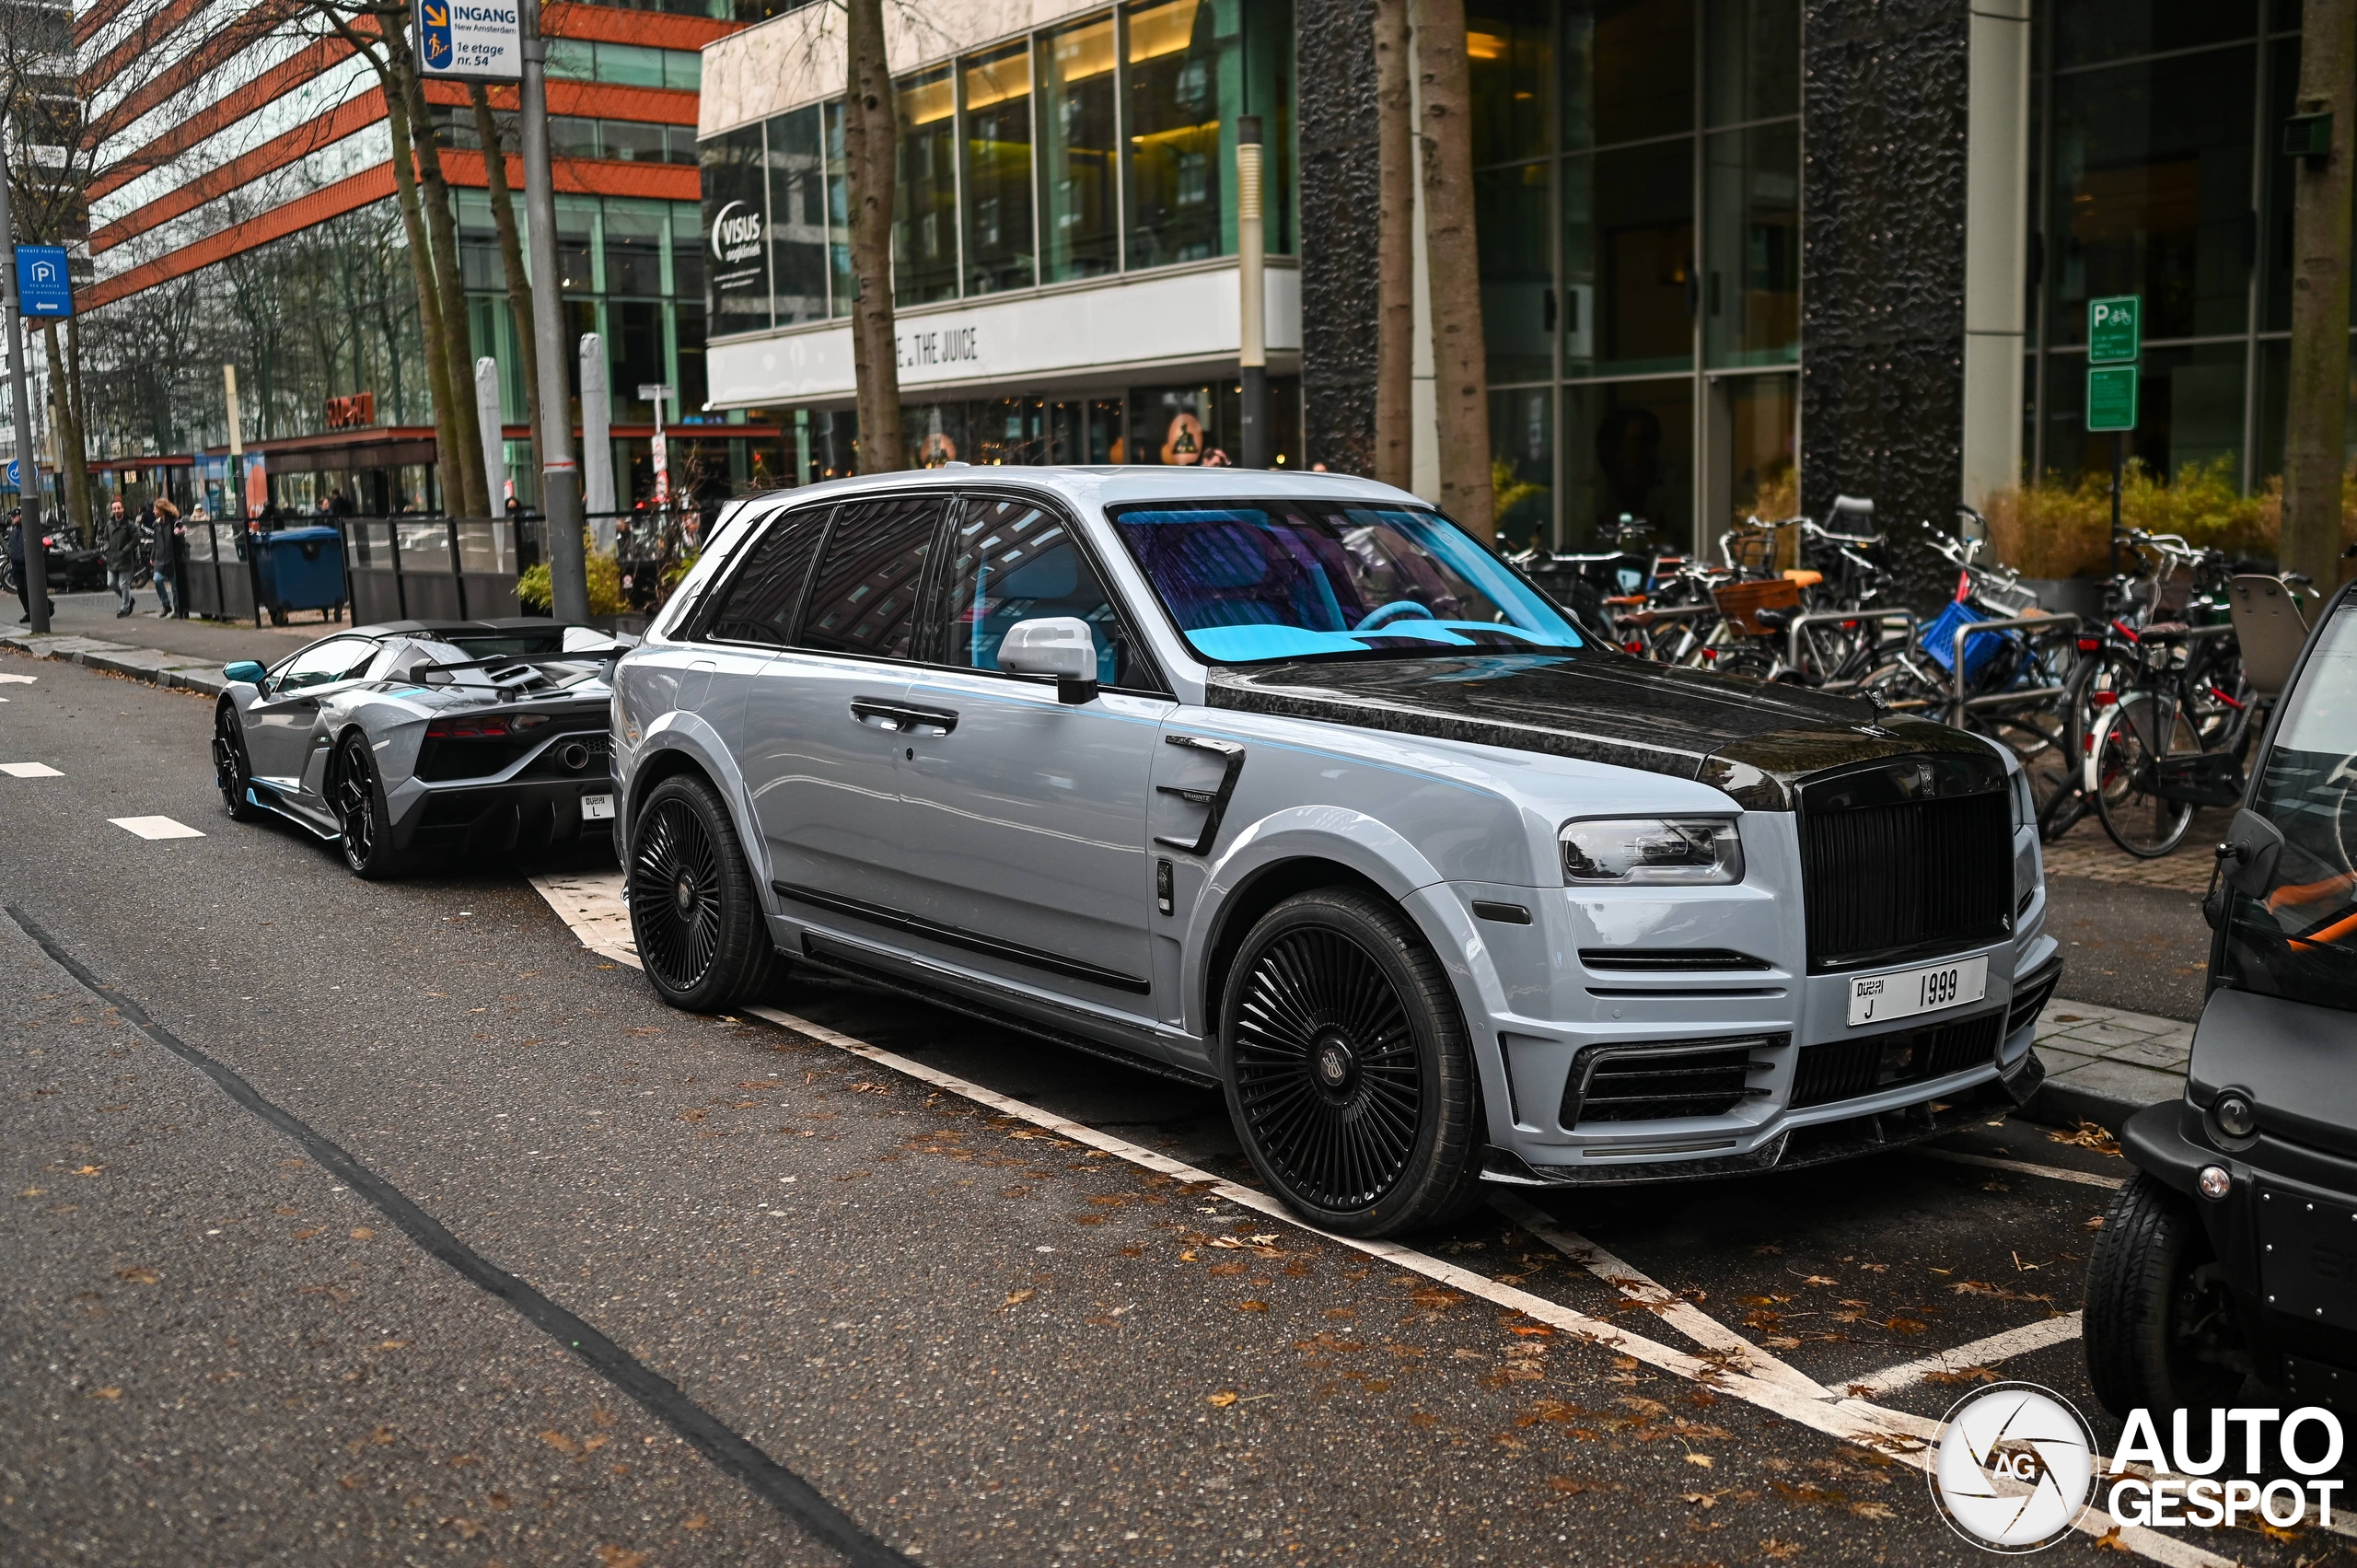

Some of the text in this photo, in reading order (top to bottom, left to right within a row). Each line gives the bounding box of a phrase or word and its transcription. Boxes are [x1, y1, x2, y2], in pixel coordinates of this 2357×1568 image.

[454, 6, 516, 23] INGANG
[454, 23, 517, 34] New Amsterdam
[457, 42, 504, 57] 1e etage
[457, 56, 489, 66] nr. 54
[722, 213, 761, 246] VISUS
[914, 332, 938, 366] THE
[942, 327, 978, 362] JUICE
[586, 796, 605, 805] DUBAI
[592, 806, 601, 817] L
[1857, 969, 1957, 1006] DUBAI 1999
[1864, 999, 1874, 1019] J
